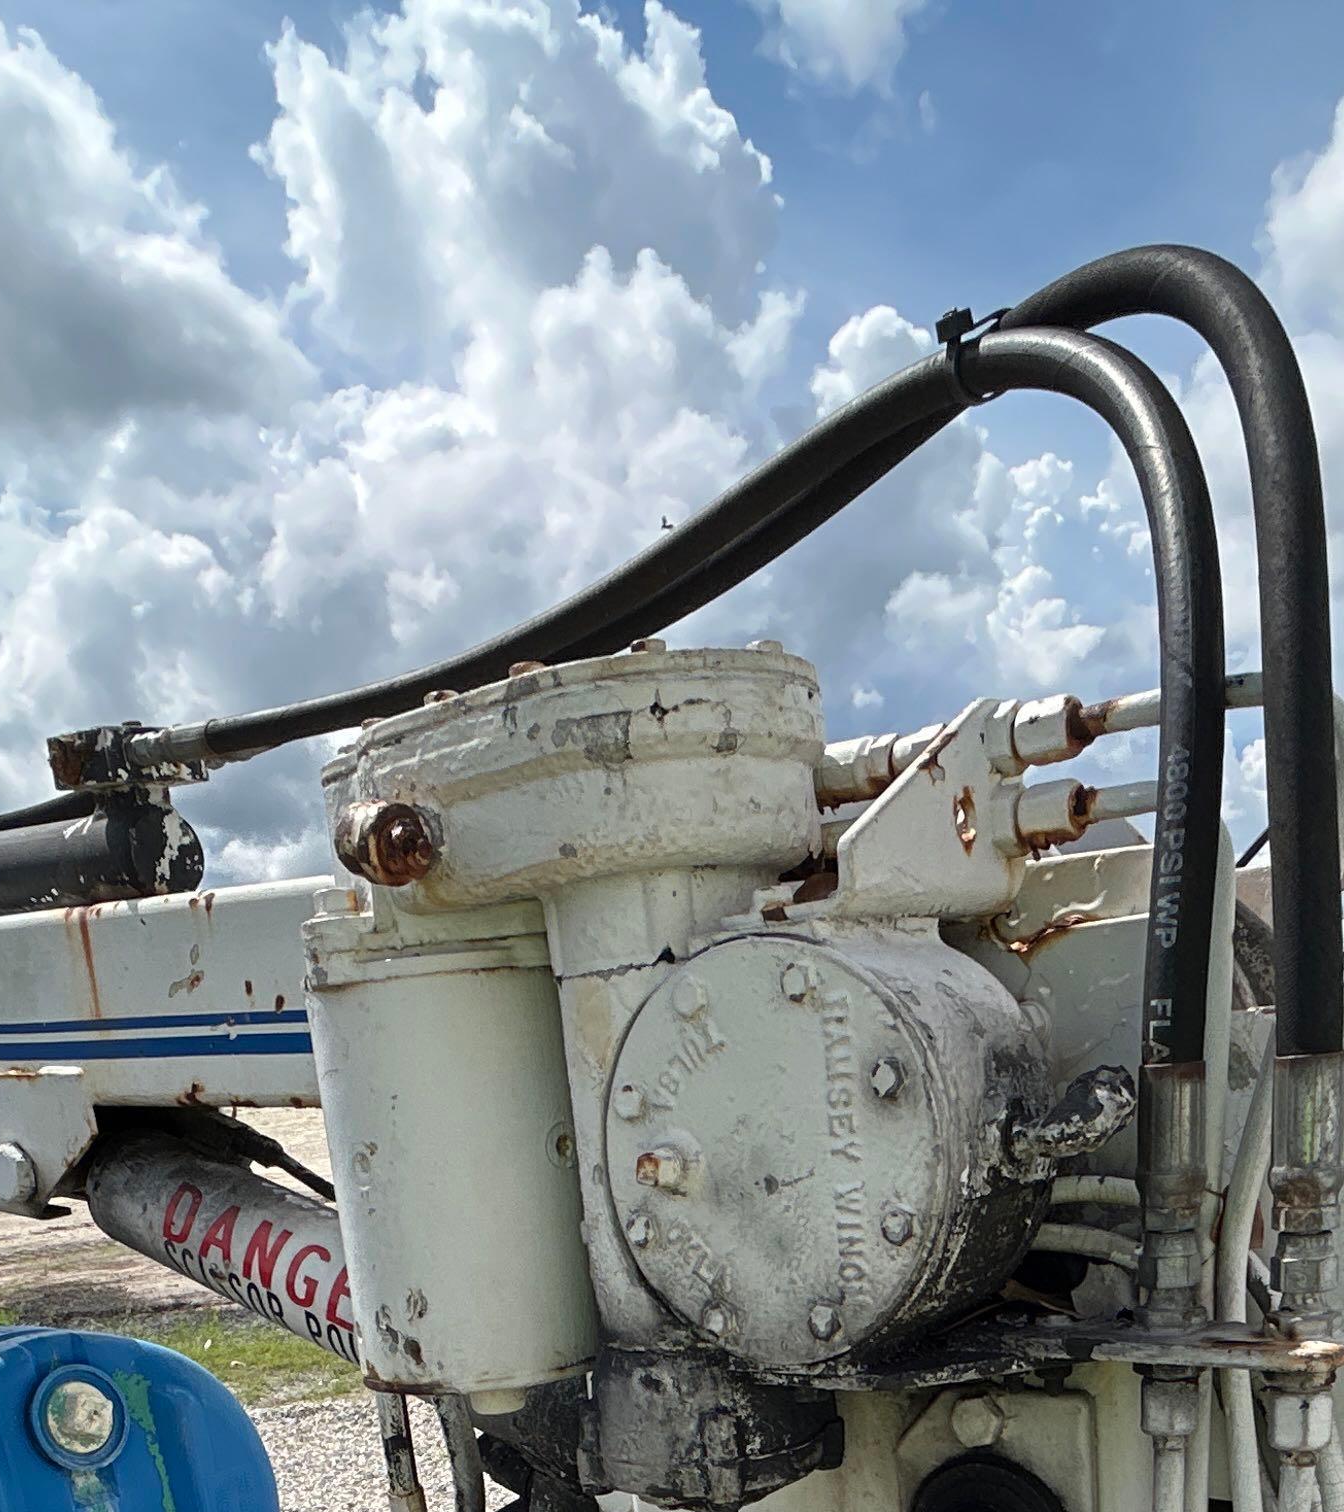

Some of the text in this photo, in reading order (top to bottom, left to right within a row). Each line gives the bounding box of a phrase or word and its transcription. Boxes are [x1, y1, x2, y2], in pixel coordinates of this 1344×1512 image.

[1158, 827, 1186, 885] PSI
[1154, 891, 1182, 949] WP
[1148, 998, 1174, 1063] FLA
[163, 1181, 355, 1332] DANGE
